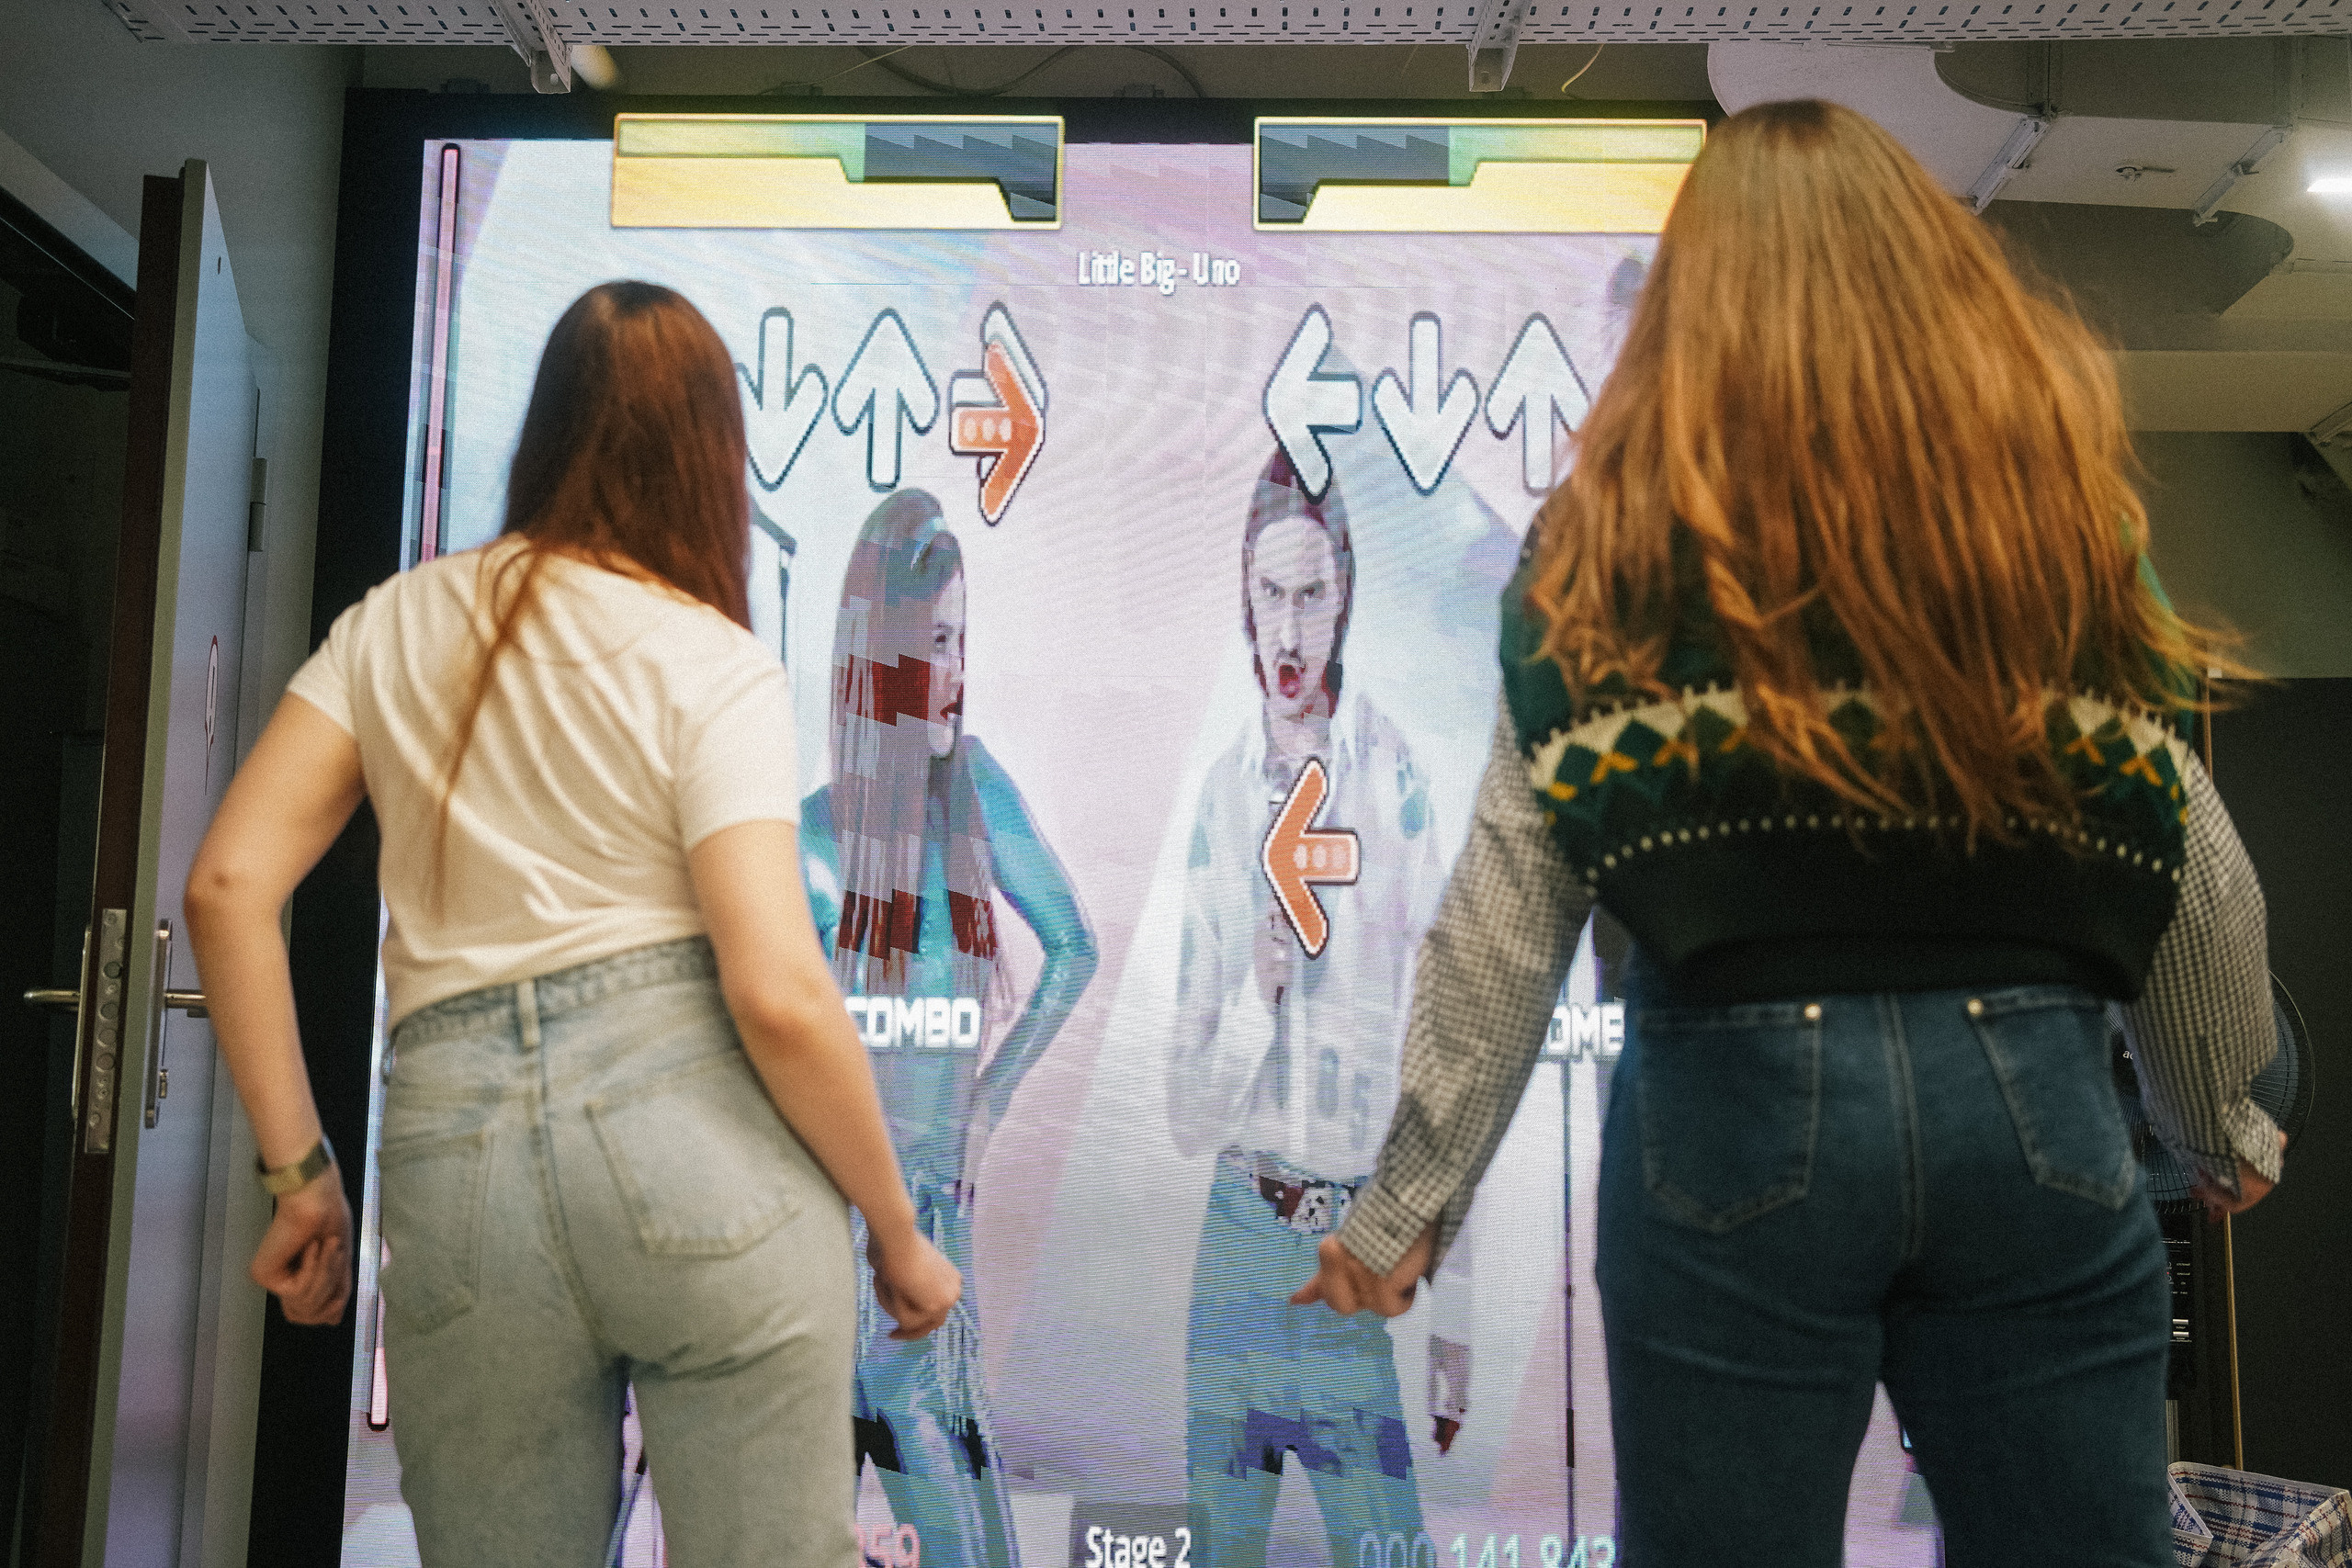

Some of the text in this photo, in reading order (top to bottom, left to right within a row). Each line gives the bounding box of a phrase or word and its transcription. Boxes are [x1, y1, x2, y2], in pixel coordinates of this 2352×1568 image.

[1078, 250, 1136, 286] Little
[1193, 251, 1241, 286] Uno
[1084, 1525, 1192, 1568] Stage 2
